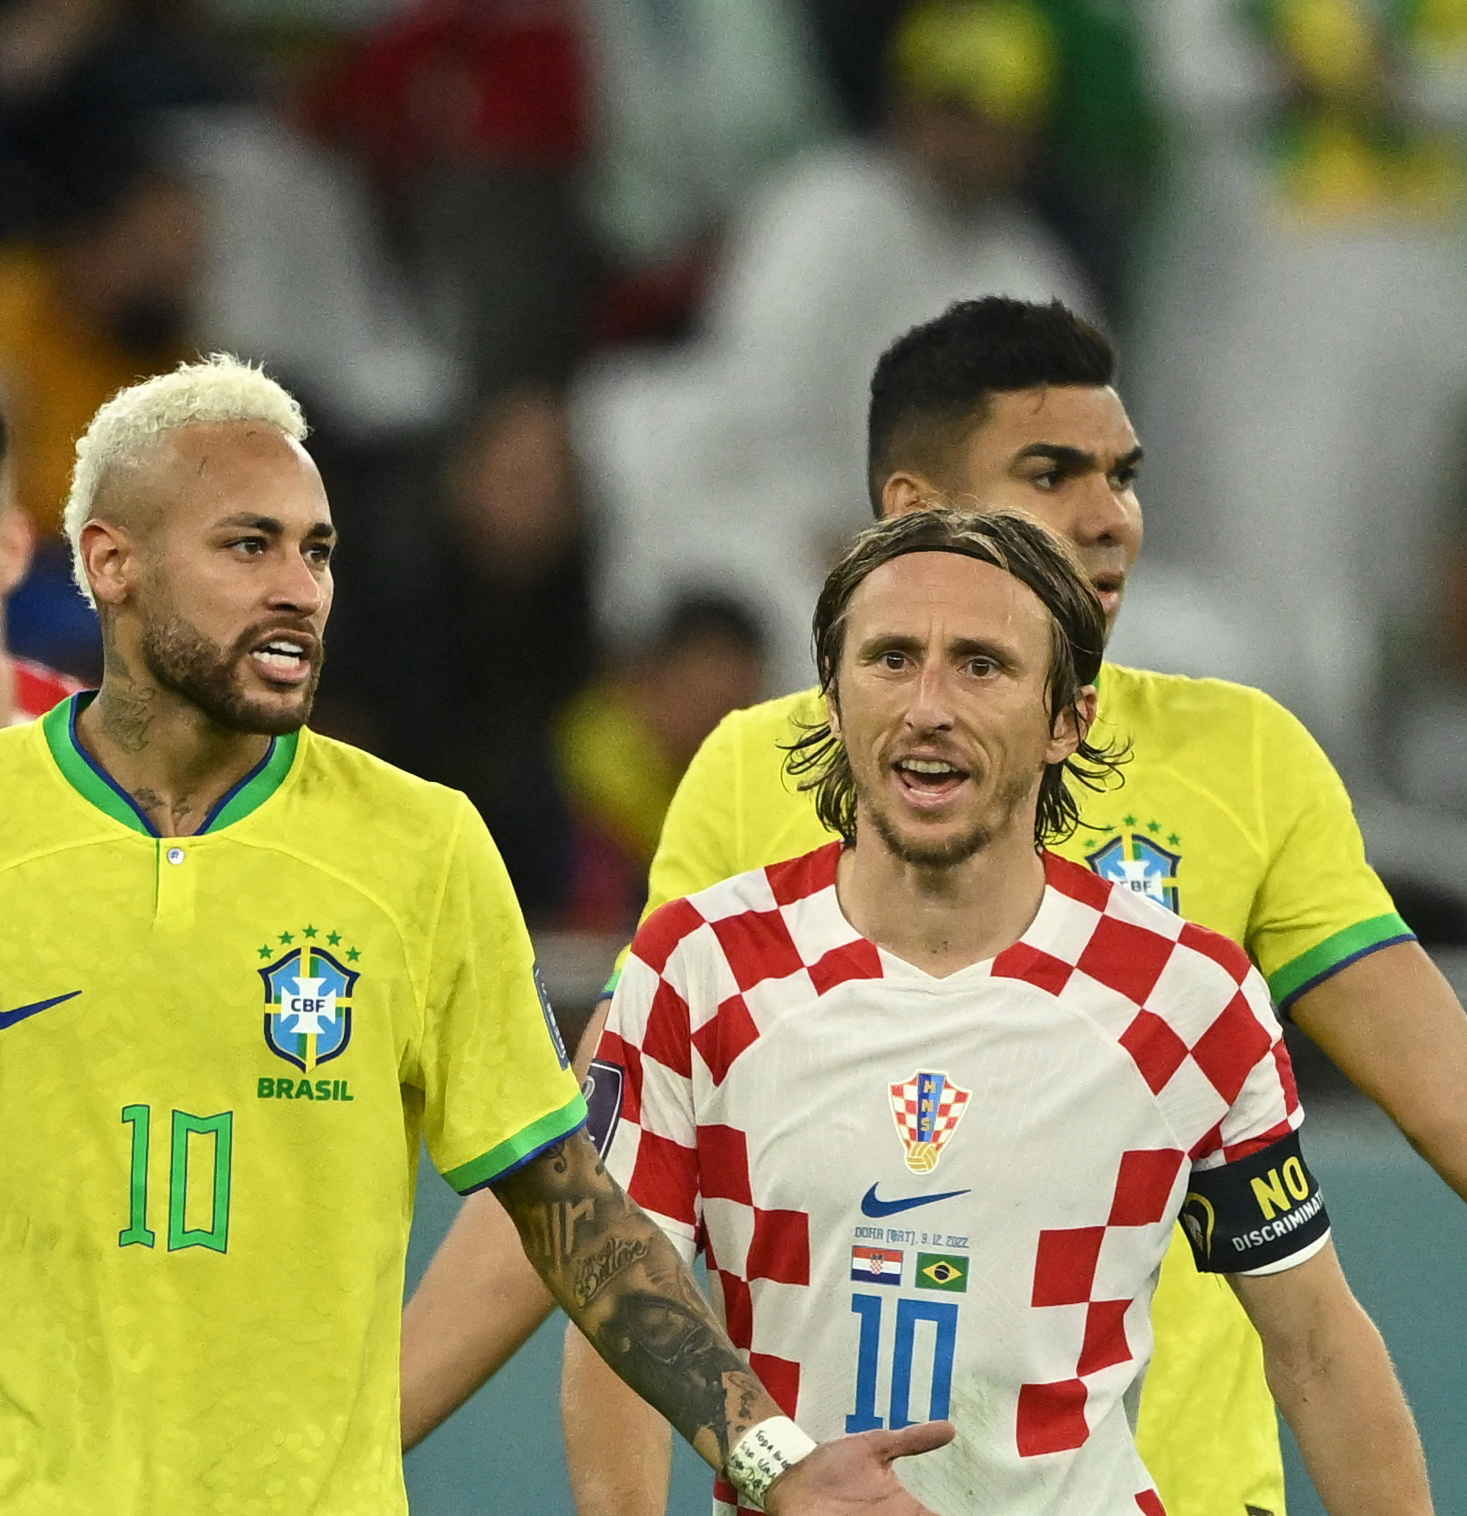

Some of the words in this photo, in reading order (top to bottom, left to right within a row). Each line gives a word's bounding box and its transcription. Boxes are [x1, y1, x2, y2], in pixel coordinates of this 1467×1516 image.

[1119, 880, 1152, 893] BF
[290, 997, 326, 1014] CBF
[257, 1077, 354, 1101] BRASIL
[118, 1103, 233, 1254] 10
[1250, 1155, 1309, 1221] NO
[845, 1293, 959, 1434] 10
